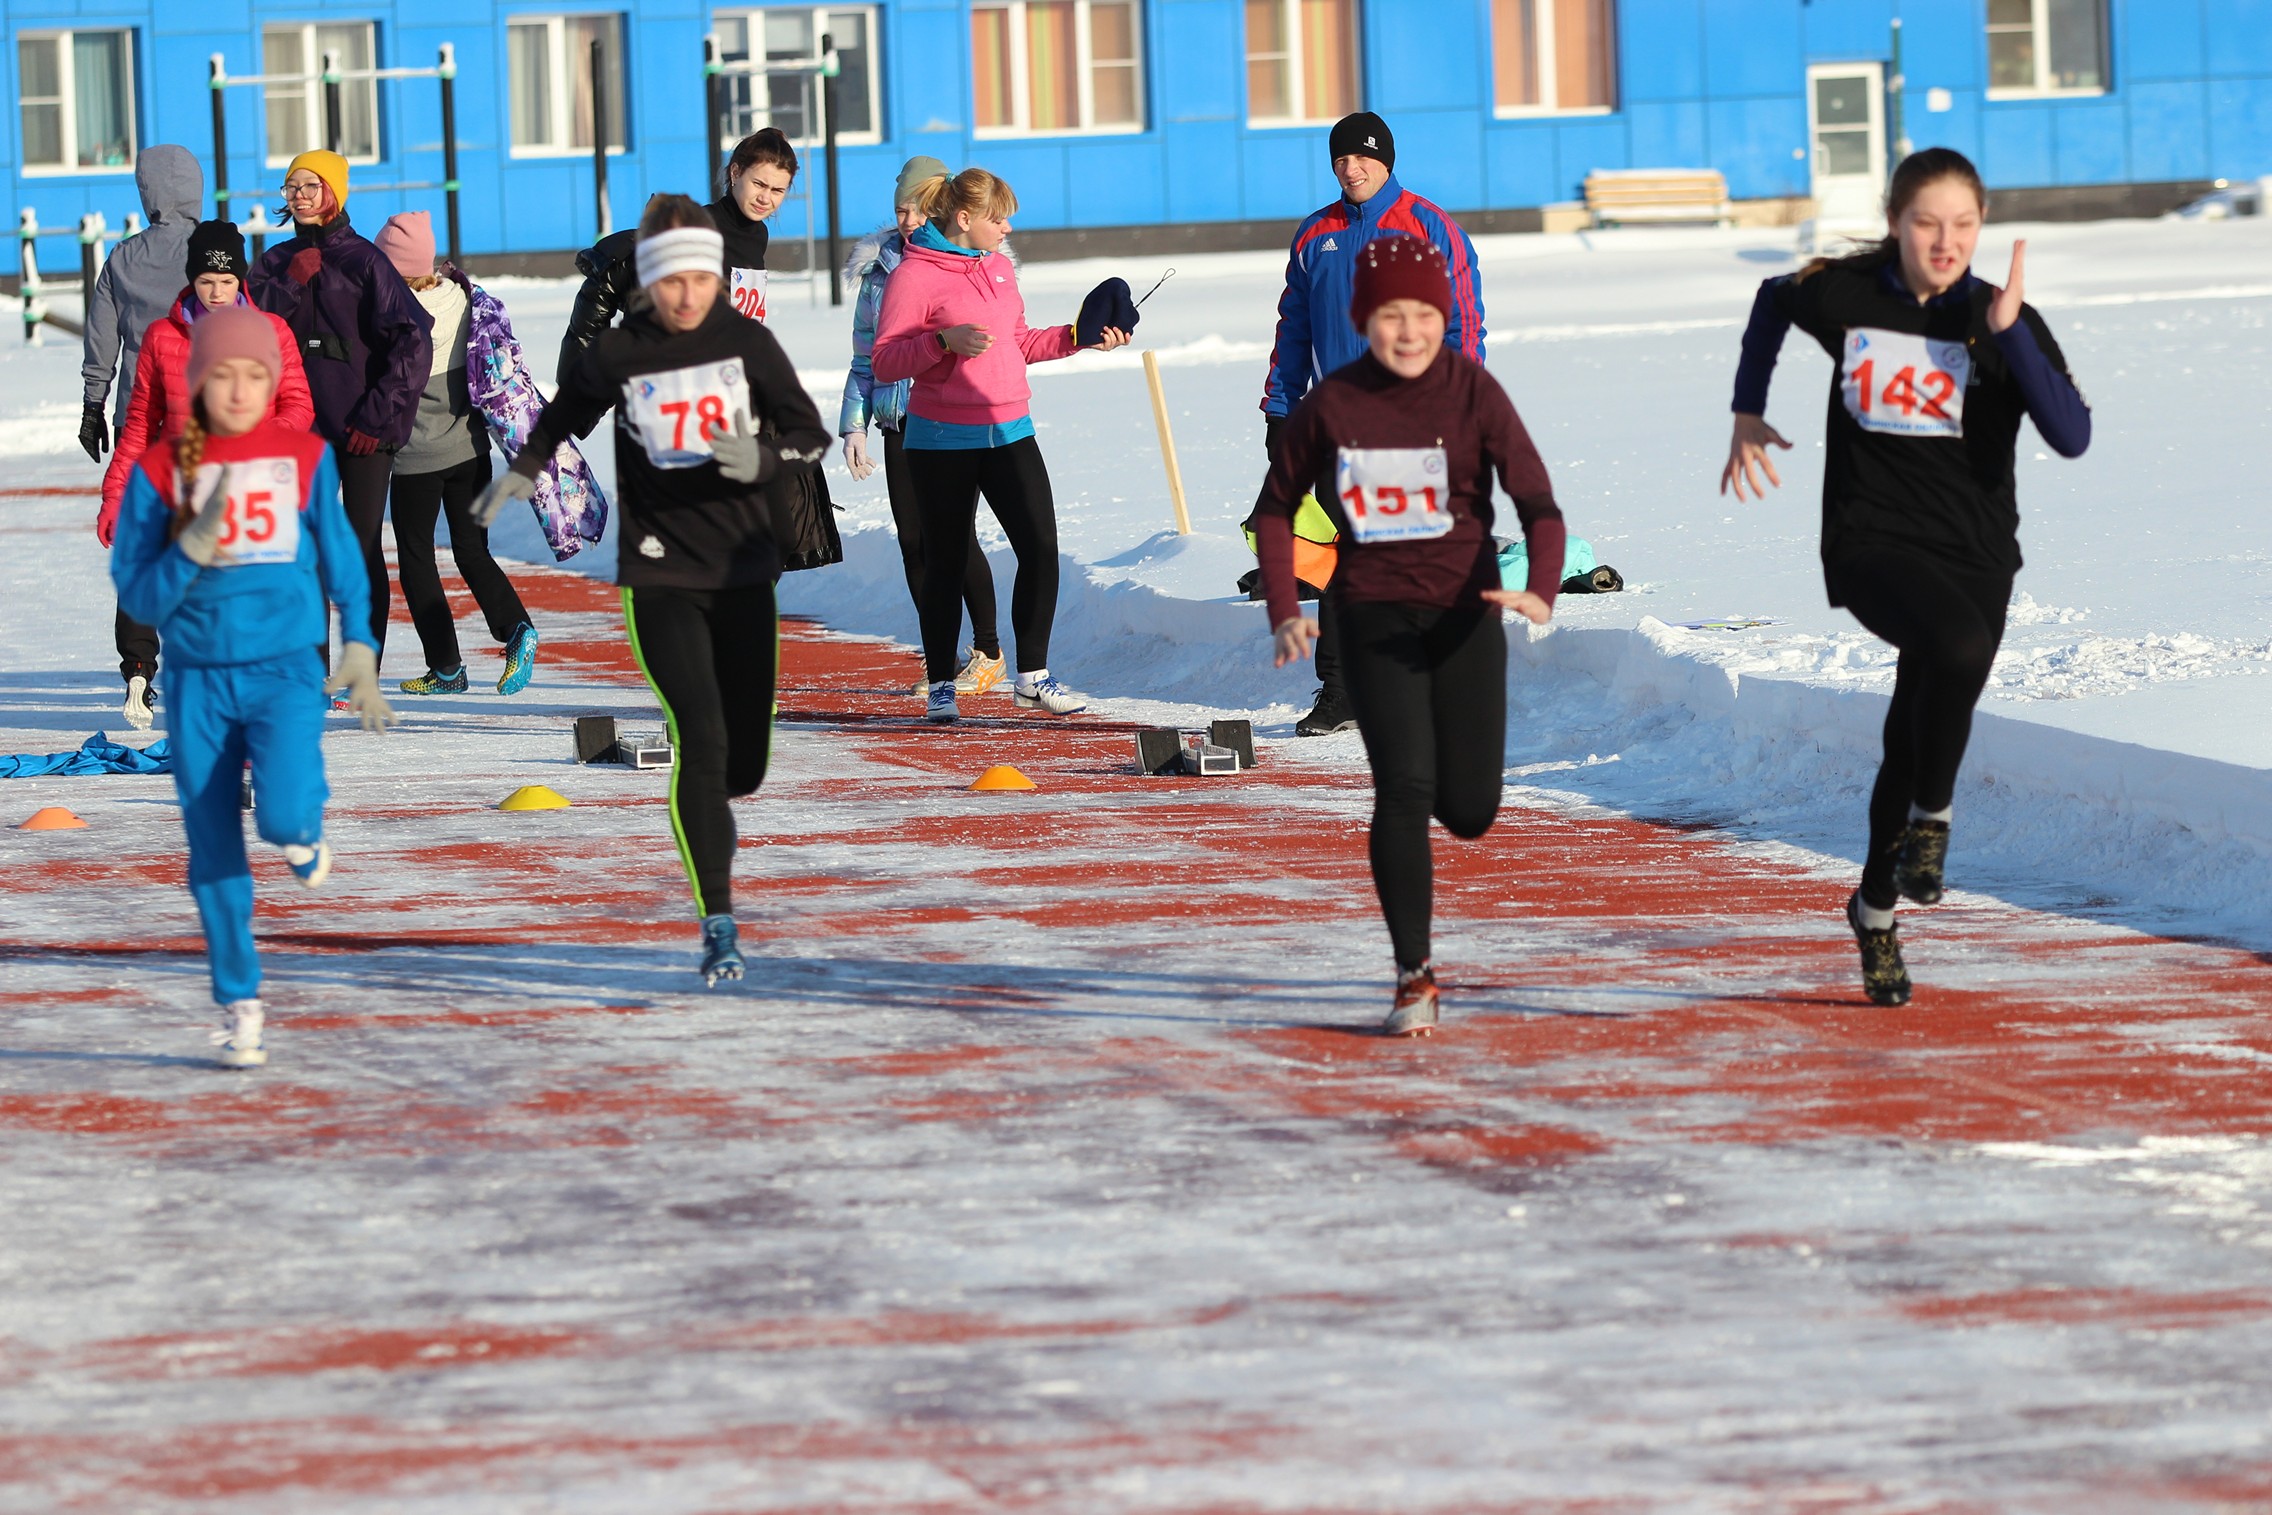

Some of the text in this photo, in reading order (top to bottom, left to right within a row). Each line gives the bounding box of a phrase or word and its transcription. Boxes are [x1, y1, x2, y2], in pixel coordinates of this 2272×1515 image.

[735, 287, 766, 323] 204
[1851, 358, 1956, 420] 142
[659, 395, 729, 451] 78
[1342, 485, 1438, 518] 151
